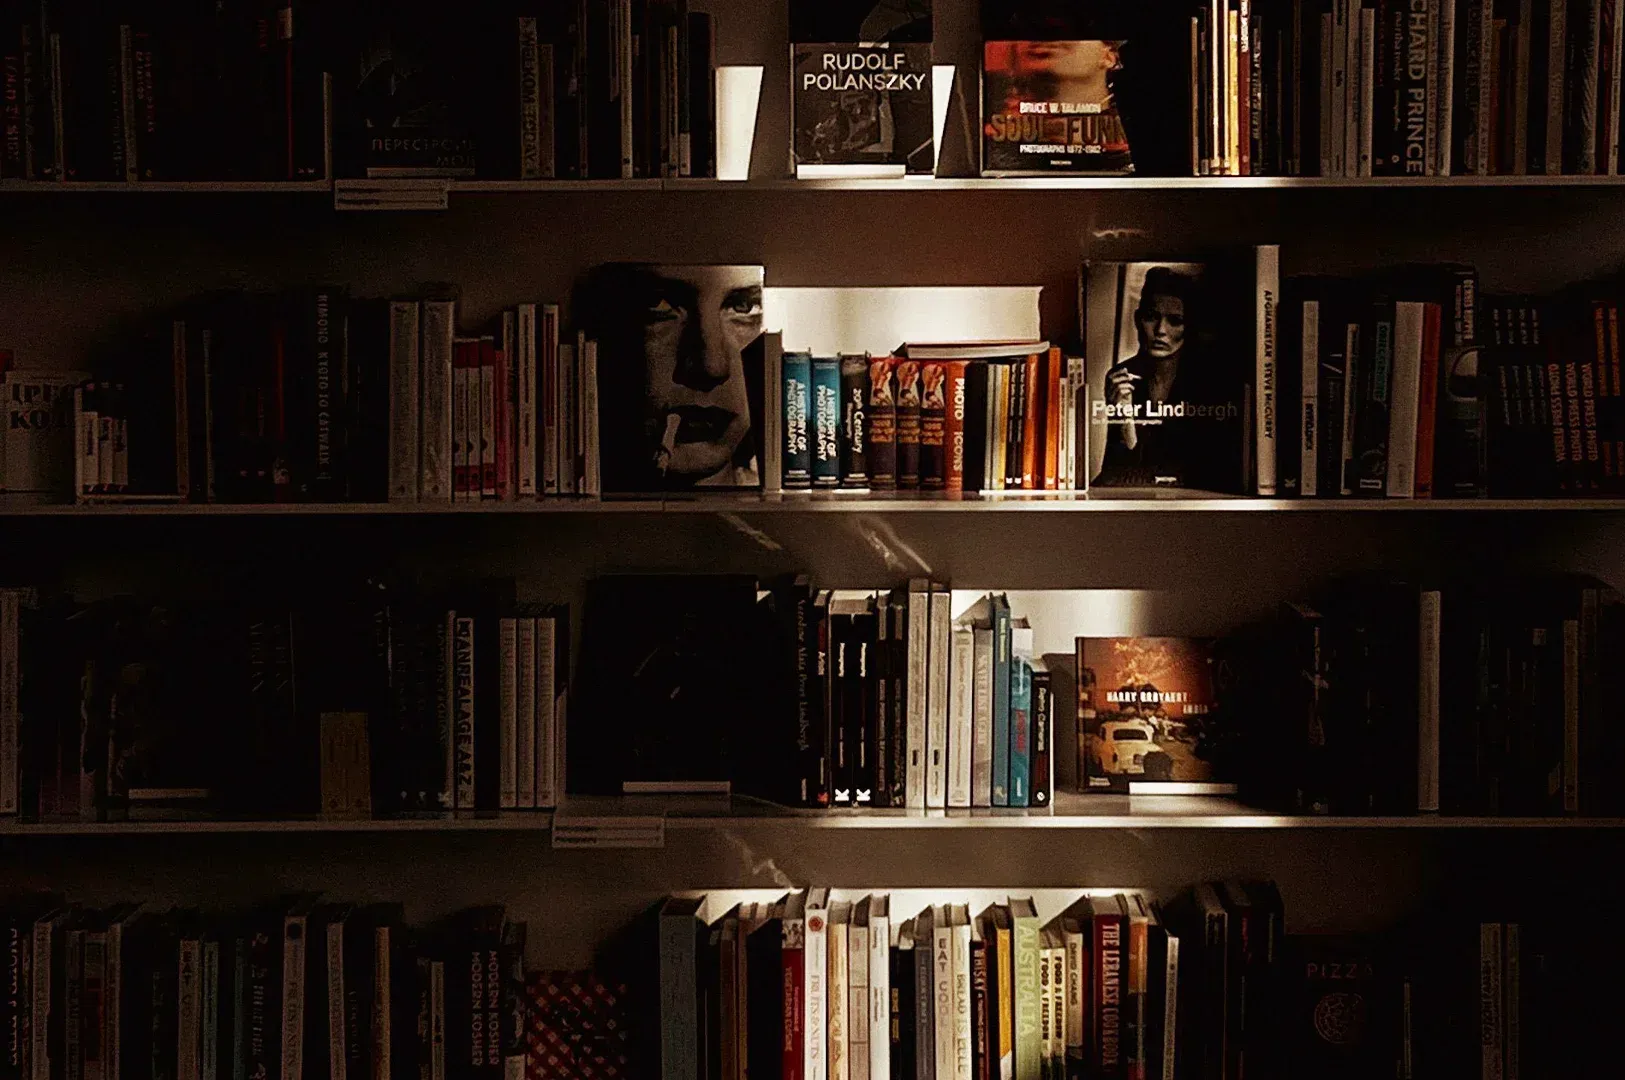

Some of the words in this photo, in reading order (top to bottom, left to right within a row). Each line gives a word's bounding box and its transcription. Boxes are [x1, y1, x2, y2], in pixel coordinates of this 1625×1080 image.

[803, 73, 926, 91] POLANSZKY
[823, 53, 905, 70] RUDOLF
[1020, 101, 1048, 114] BRUCE
[1061, 102, 1102, 114] TALAMON
[1405, 87, 1426, 175] PRINCE
[316, 293, 329, 344] KIMONO
[1264, 289, 1273, 358] AFGHANISTAN
[1264, 362, 1273, 390] STEVE
[787, 378, 797, 455] PHOTOGRAPHY
[797, 391, 807, 435] HISTORY
[826, 397, 837, 441] HISTORY
[954, 377, 965, 421] PHOTO
[1092, 400, 1142, 417] Peter
[1145, 399, 1238, 421] Lindbergh
[1264, 391, 1274, 439] McCURRY
[797, 436, 807, 451] OF
[816, 384, 827, 462] PHOTOGRAPHY
[852, 410, 865, 454] Century
[827, 442, 837, 458] OF
[953, 431, 964, 472] ICONS
[1069, 942, 1078, 970] DAVID
[1102, 922, 1120, 947] THE
[471, 951, 483, 1010] MODERN
[487, 949, 499, 1009] MODERN
[1016, 920, 1036, 1036] AUSTRALIA
[1041, 957, 1049, 986] FOOD
[1054, 956, 1062, 985] FOOD
[1069, 971, 1078, 1006] CHANG
[1102, 949, 1120, 1006] LEBANESE
[488, 1011, 499, 1066] KOSHER
[1055, 995, 1063, 1039] FREEDOM
[1102, 1007, 1120, 1066] COOKBOOK
[471, 1012, 483, 1067] KOSHER
